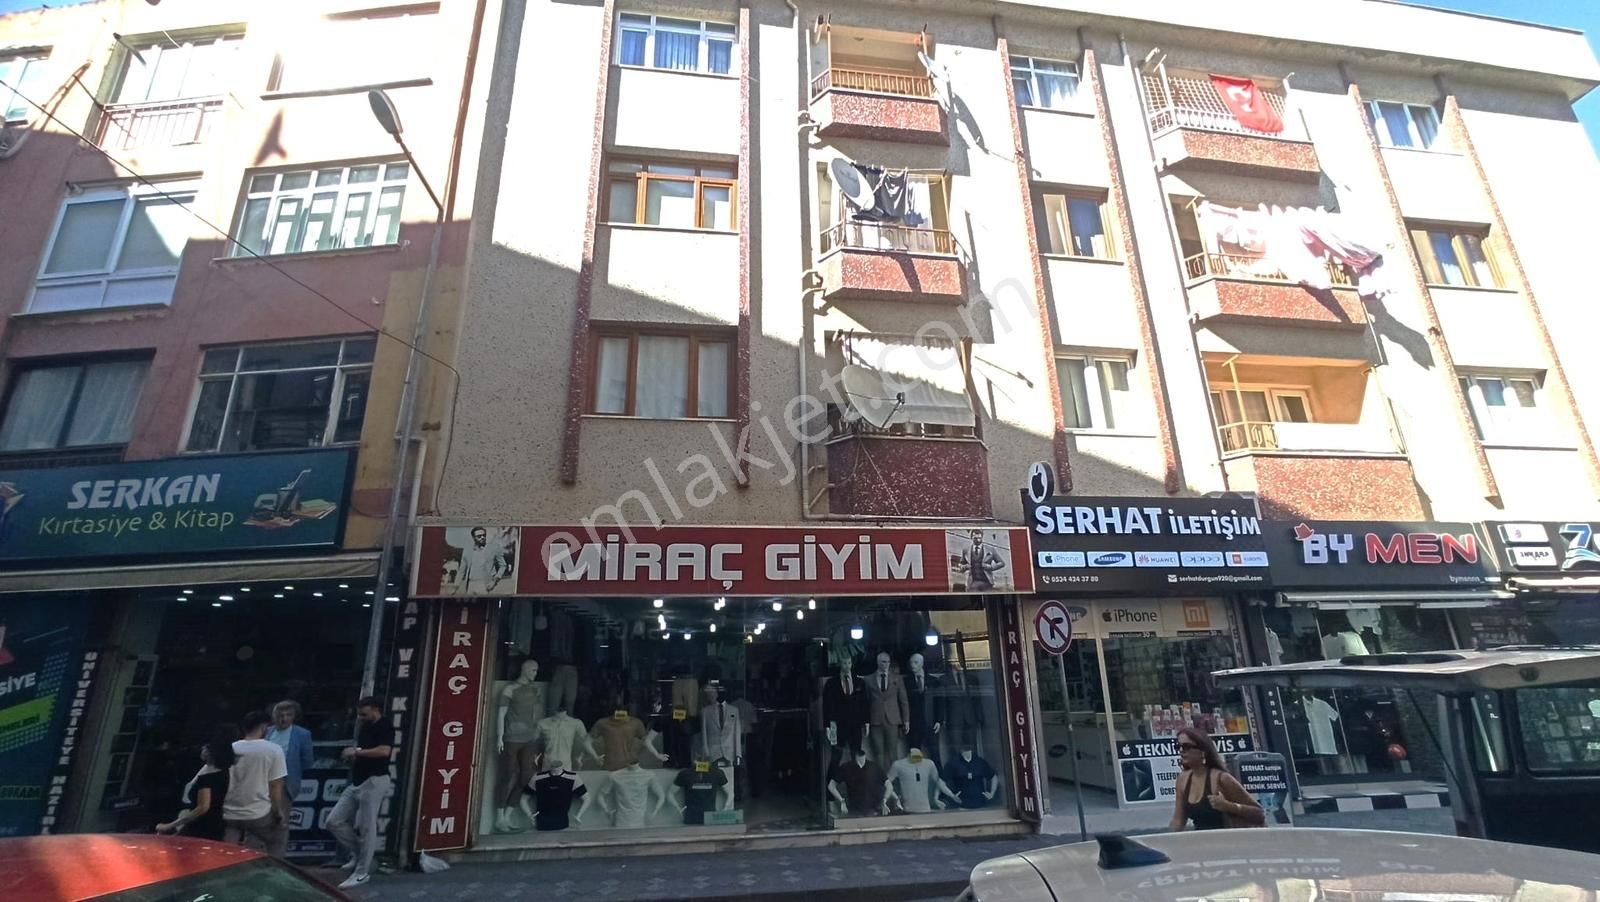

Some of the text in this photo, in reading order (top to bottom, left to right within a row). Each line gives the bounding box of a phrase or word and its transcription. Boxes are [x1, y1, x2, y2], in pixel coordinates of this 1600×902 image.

[67, 473, 221, 511] SERKAN
[38, 508, 234, 537] Kırtasiye & Kitap
[1034, 505, 1162, 535] SERHAT
[547, 533, 924, 590] MİRAÇ GİYİM
[1053, 554, 1080, 563] iPhone
[1150, 556, 1177, 564] HUAWEI
[1303, 532, 1478, 564] BY MEN
[1114, 608, 1158, 623] iPhone
[398, 648, 414, 678] VE
[429, 600, 472, 834] İRAÇ GİYİM
[1003, 606, 1035, 813] İRAÇ GİYİM
[1135, 737, 1235, 757] TEKNİ VİS
[1156, 772, 1179, 781] TELEFO
